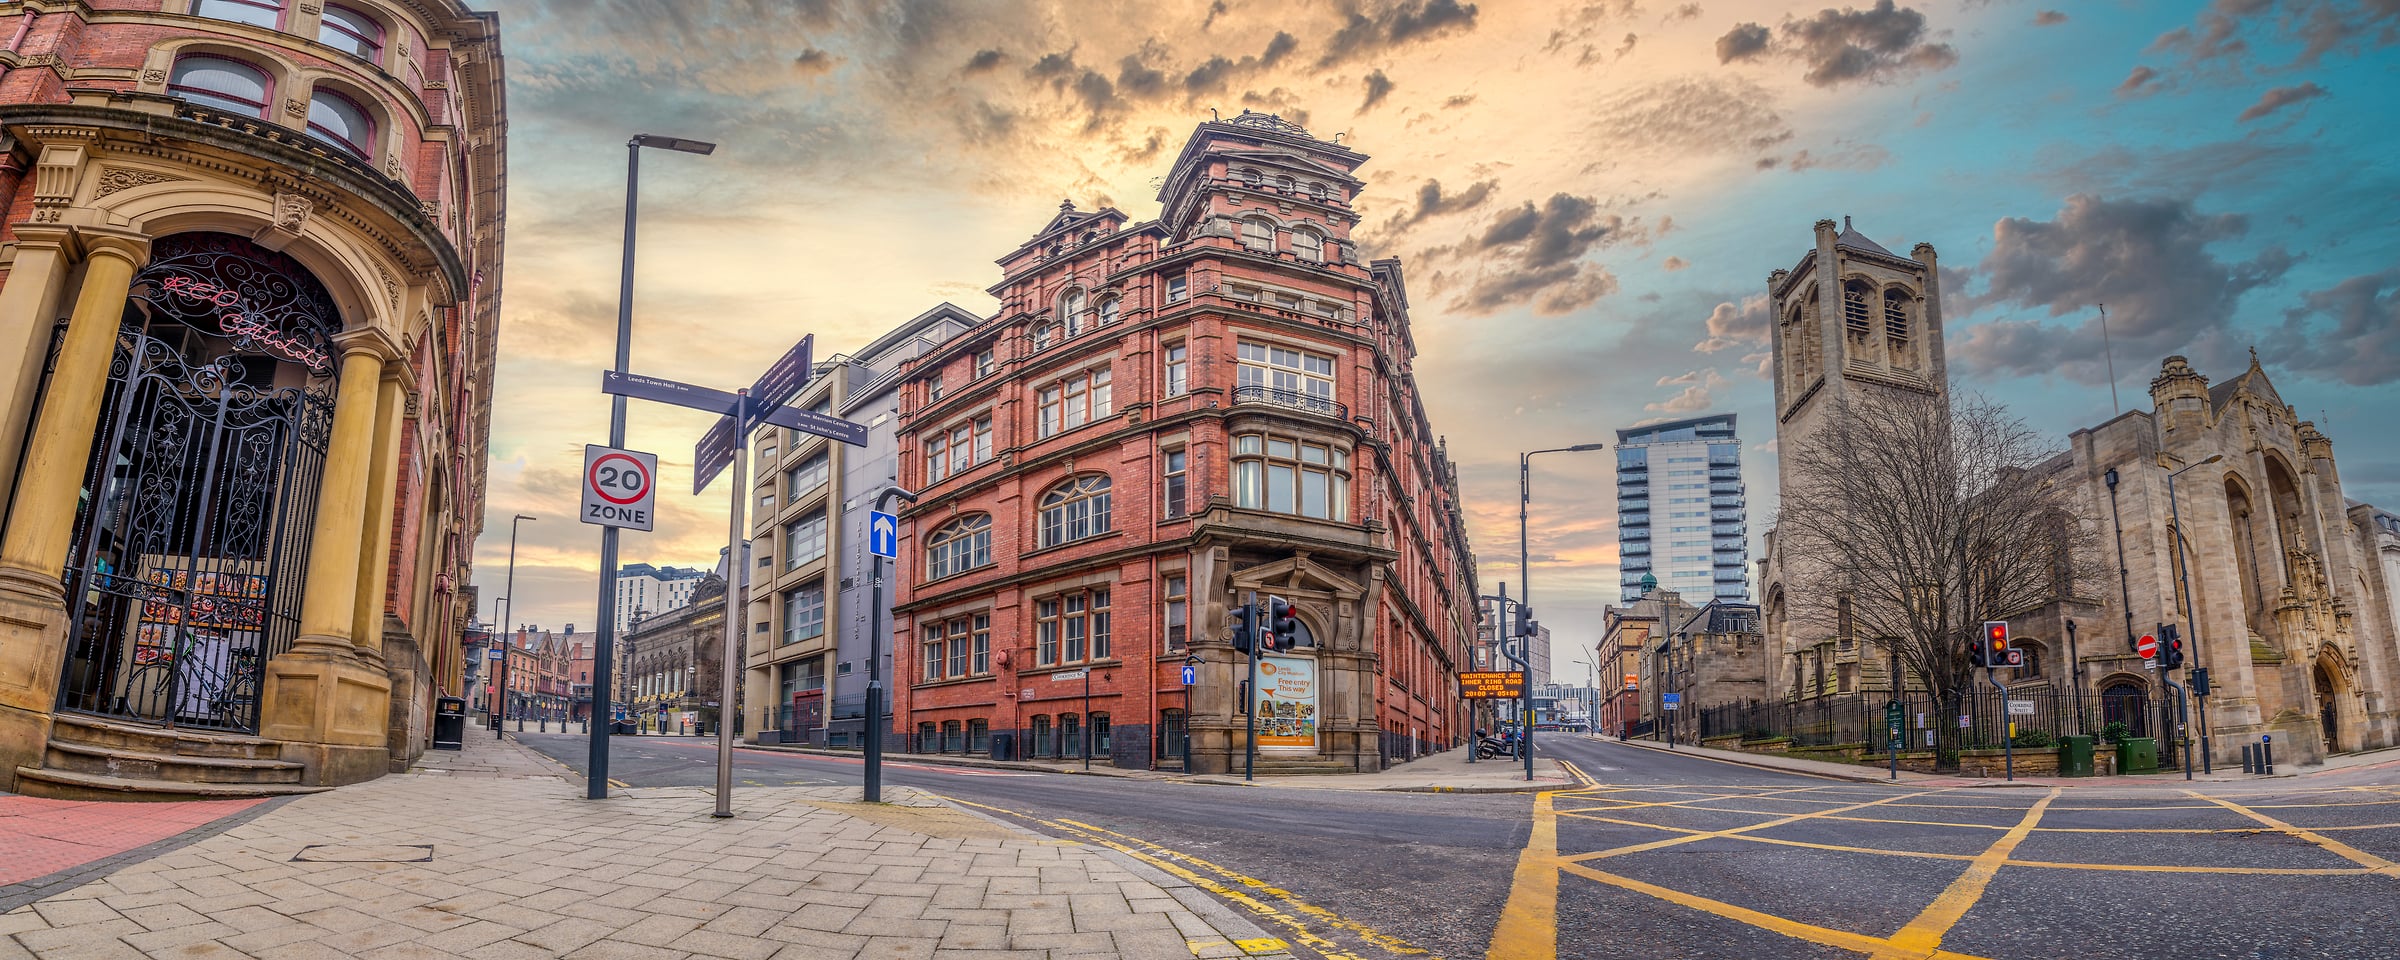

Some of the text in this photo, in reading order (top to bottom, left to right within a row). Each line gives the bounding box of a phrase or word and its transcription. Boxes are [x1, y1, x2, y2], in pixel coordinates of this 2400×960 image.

[628, 376, 645, 384] Leeds
[646, 379, 662, 387] Town
[812, 414, 833, 424] Merrion
[832, 420, 849, 428] Centre
[816, 425, 832, 434] John's
[832, 430, 849, 438] Centre
[600, 466, 641, 491] 20
[589, 503, 645, 524] ZONE
